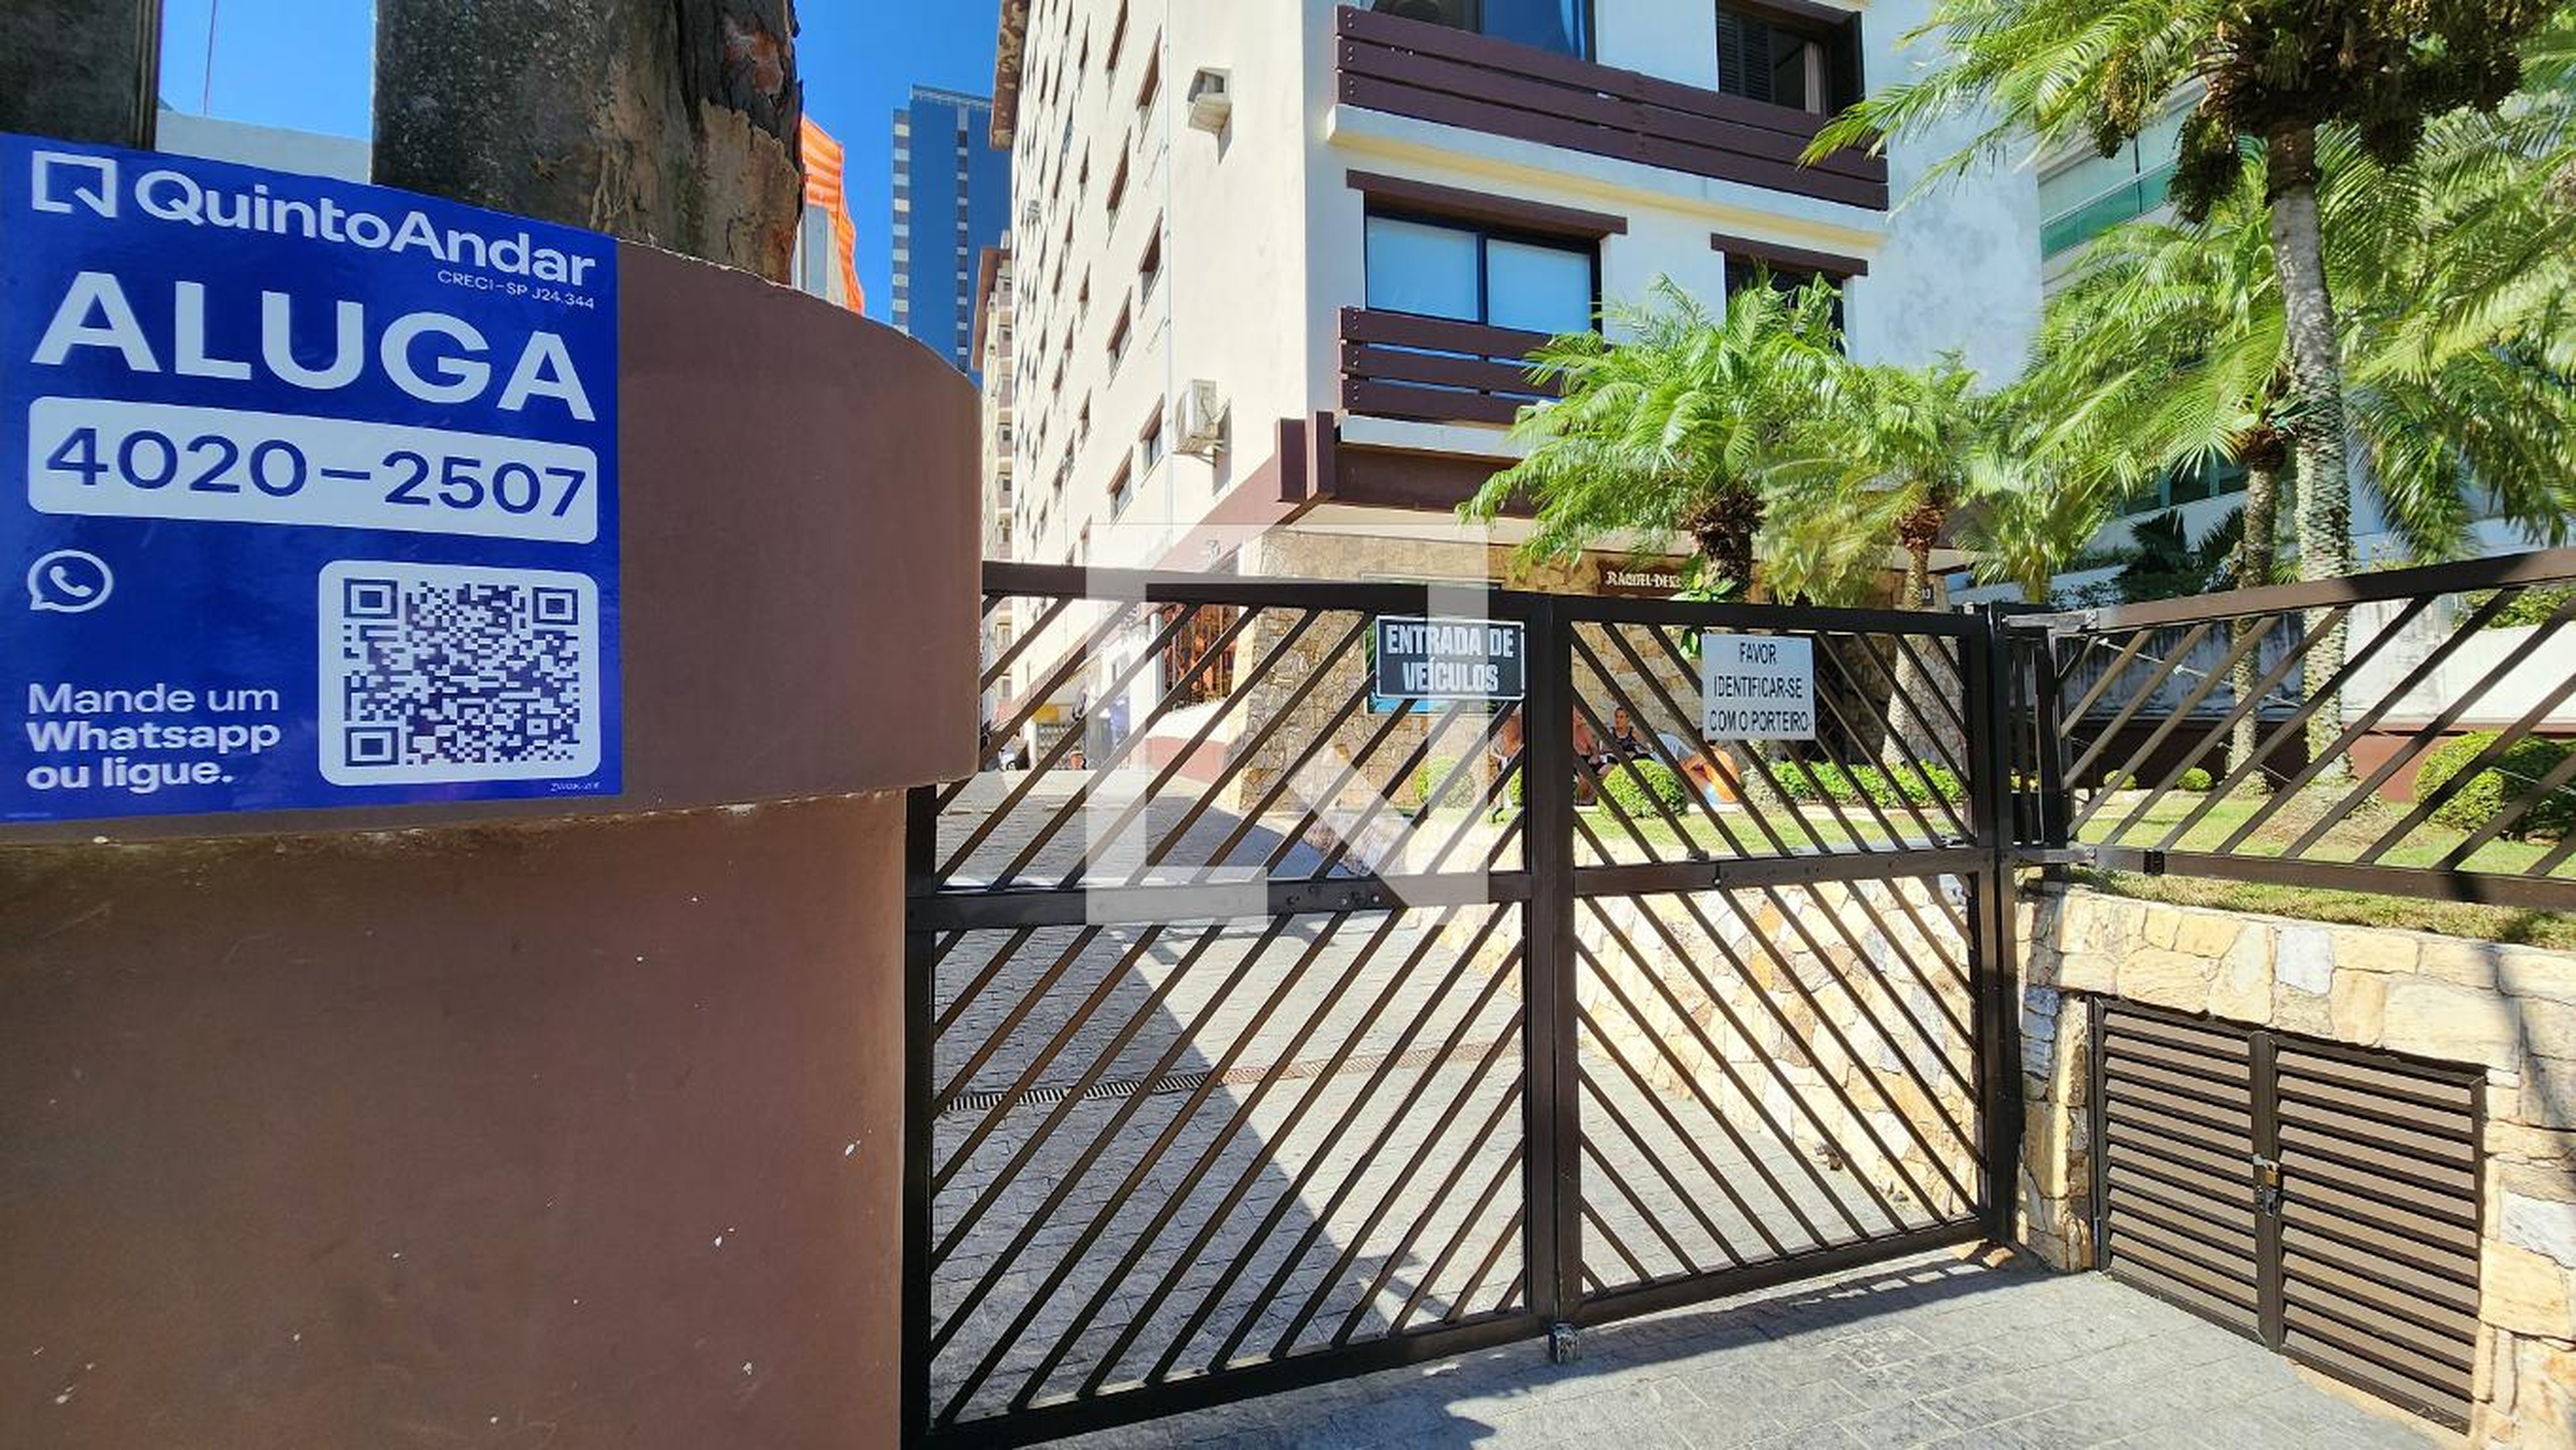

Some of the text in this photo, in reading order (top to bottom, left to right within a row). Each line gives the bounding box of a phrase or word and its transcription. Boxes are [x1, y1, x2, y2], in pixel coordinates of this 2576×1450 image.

[135, 170, 596, 286] QuintoAndar
[437, 270, 528, 296] CRECI-SP
[30, 271, 596, 422] ALUGA
[44, 426, 588, 518] 4020-2507
[1385, 624, 1513, 657] ENTRADA DE
[1739, 643, 1777, 664] FAVOR
[1402, 657, 1498, 692] VEÍCULOS
[1714, 675, 1803, 698] IDENTIFICAR-SE
[29, 683, 280, 714] Mande um
[26, 720, 281, 755] Whatsapp
[1710, 710, 1809, 732] COM O PORTEIRO
[26, 755, 234, 794] ou ligue.
